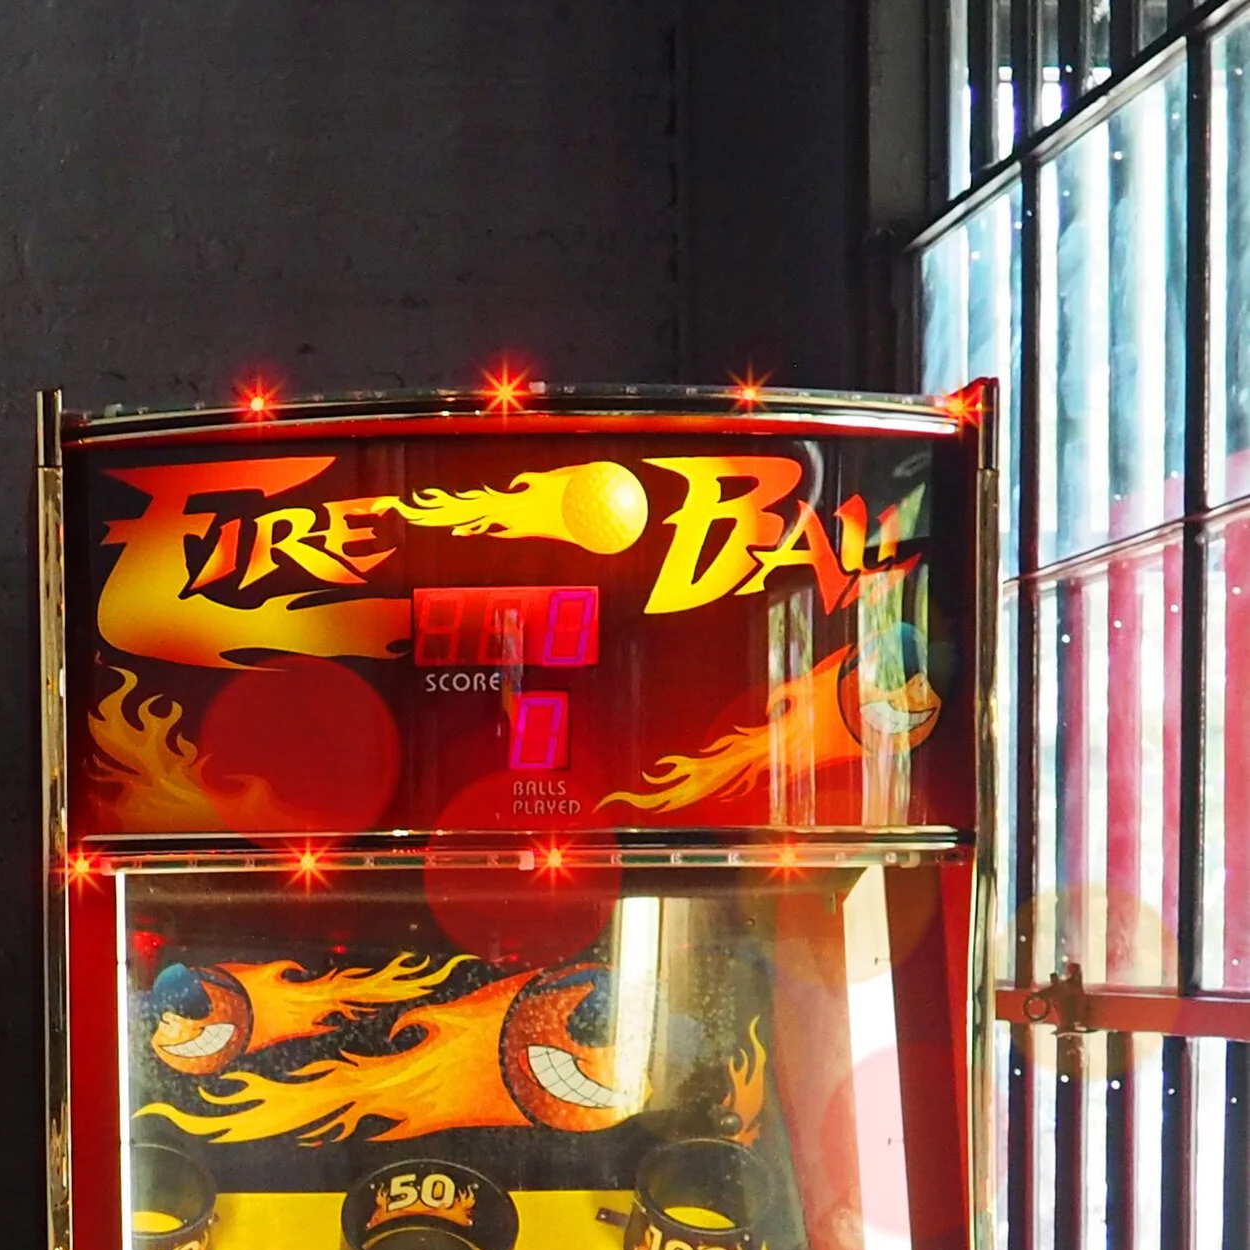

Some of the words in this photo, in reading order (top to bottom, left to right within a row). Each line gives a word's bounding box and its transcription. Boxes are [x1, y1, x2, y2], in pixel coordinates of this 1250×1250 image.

[424, 672, 501, 693] SCORE
[509, 696, 564, 770] 0
[512, 780, 567, 796] BALLS
[512, 799, 582, 815] PLAYED
[385, 1172, 458, 1213] 50
